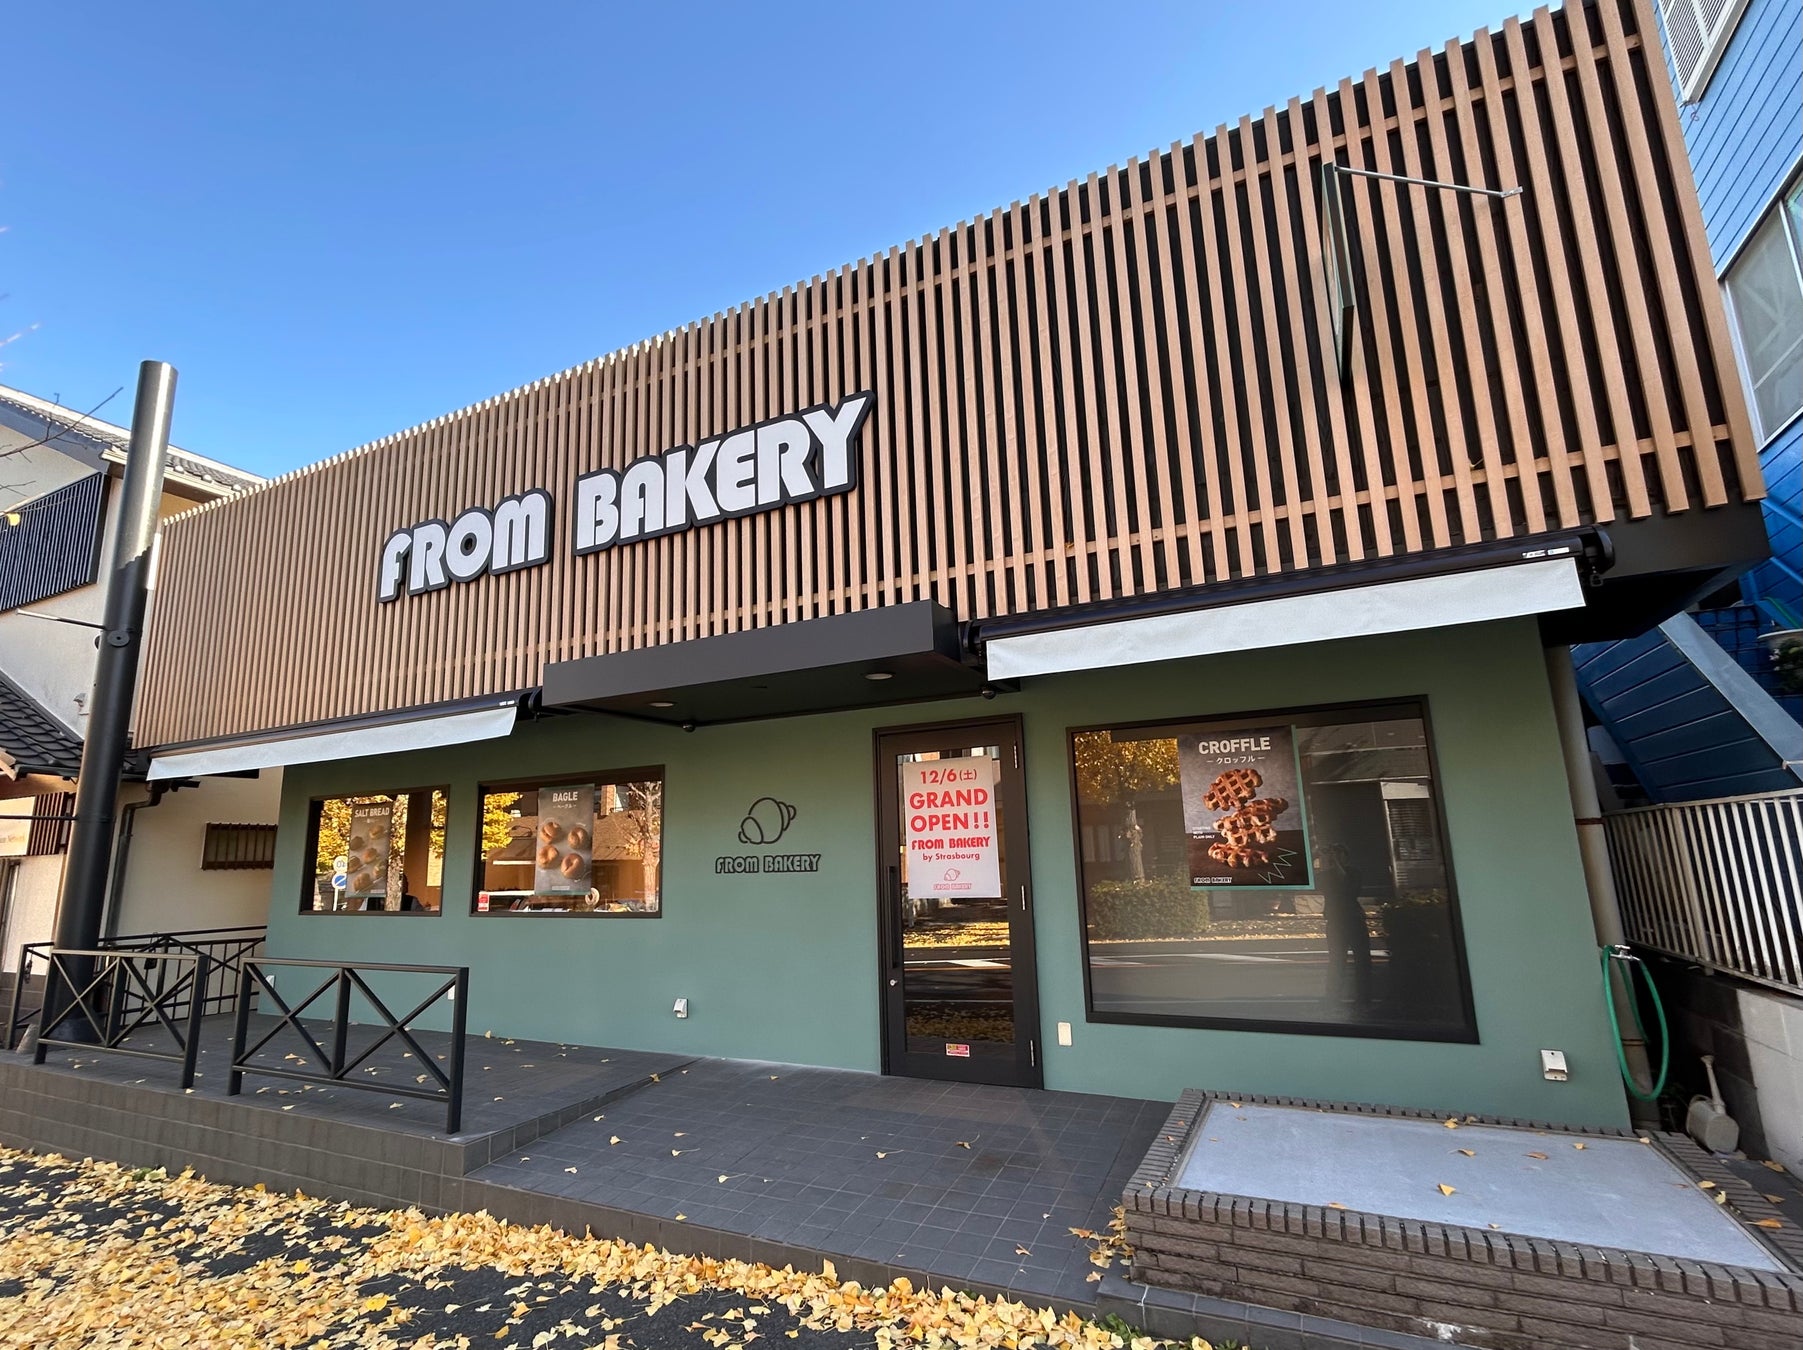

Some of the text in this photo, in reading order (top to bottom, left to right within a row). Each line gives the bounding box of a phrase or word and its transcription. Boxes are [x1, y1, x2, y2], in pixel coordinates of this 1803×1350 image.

[379, 396, 869, 600] FROM BAKERY
[1198, 736, 1271, 755] CROFFLE
[552, 791, 578, 803] BAGLE
[909, 788, 988, 810] GRAND
[354, 807, 390, 818] SALT BREAD
[911, 836, 991, 851] FROM BAKERY
[715, 854, 821, 874] FROM BAKERY
[922, 852, 980, 862] by Strasbourg
